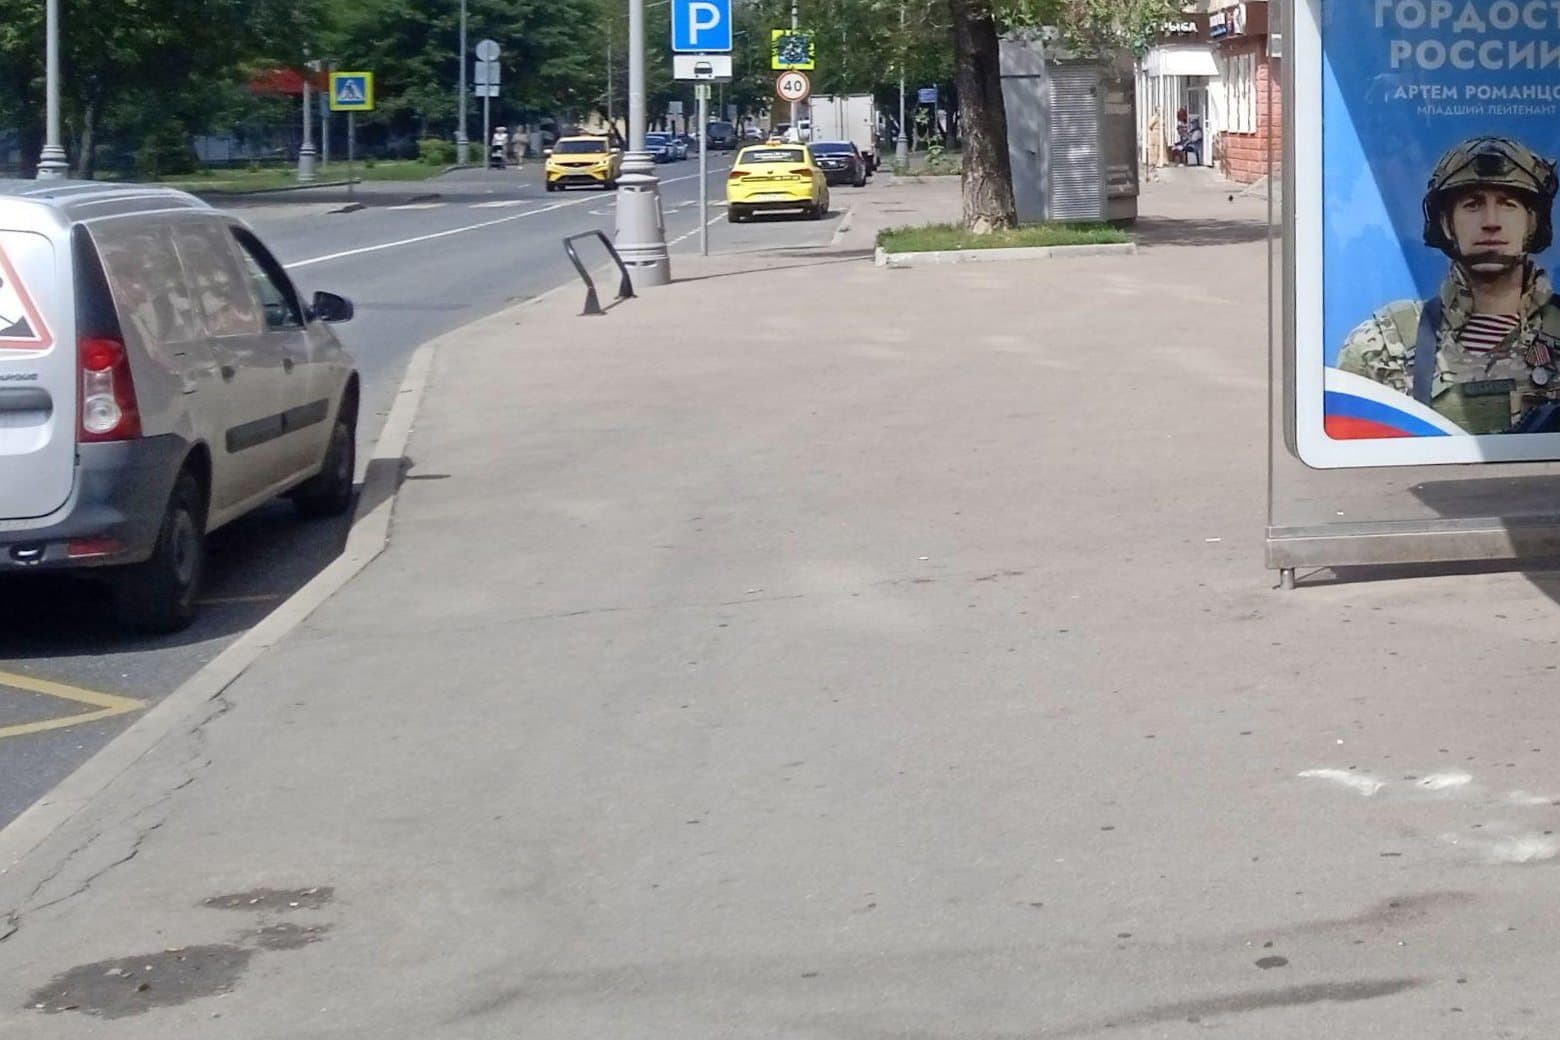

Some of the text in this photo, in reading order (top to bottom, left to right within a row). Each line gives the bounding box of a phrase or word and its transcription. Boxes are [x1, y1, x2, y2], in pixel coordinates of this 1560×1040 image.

[783, 80, 803, 93] 40
[1393, 84, 1458, 100] АРТЕМ
[1416, 103, 1557, 117] МЛАДШИЙ ЛЕЙТЕНАНТ
